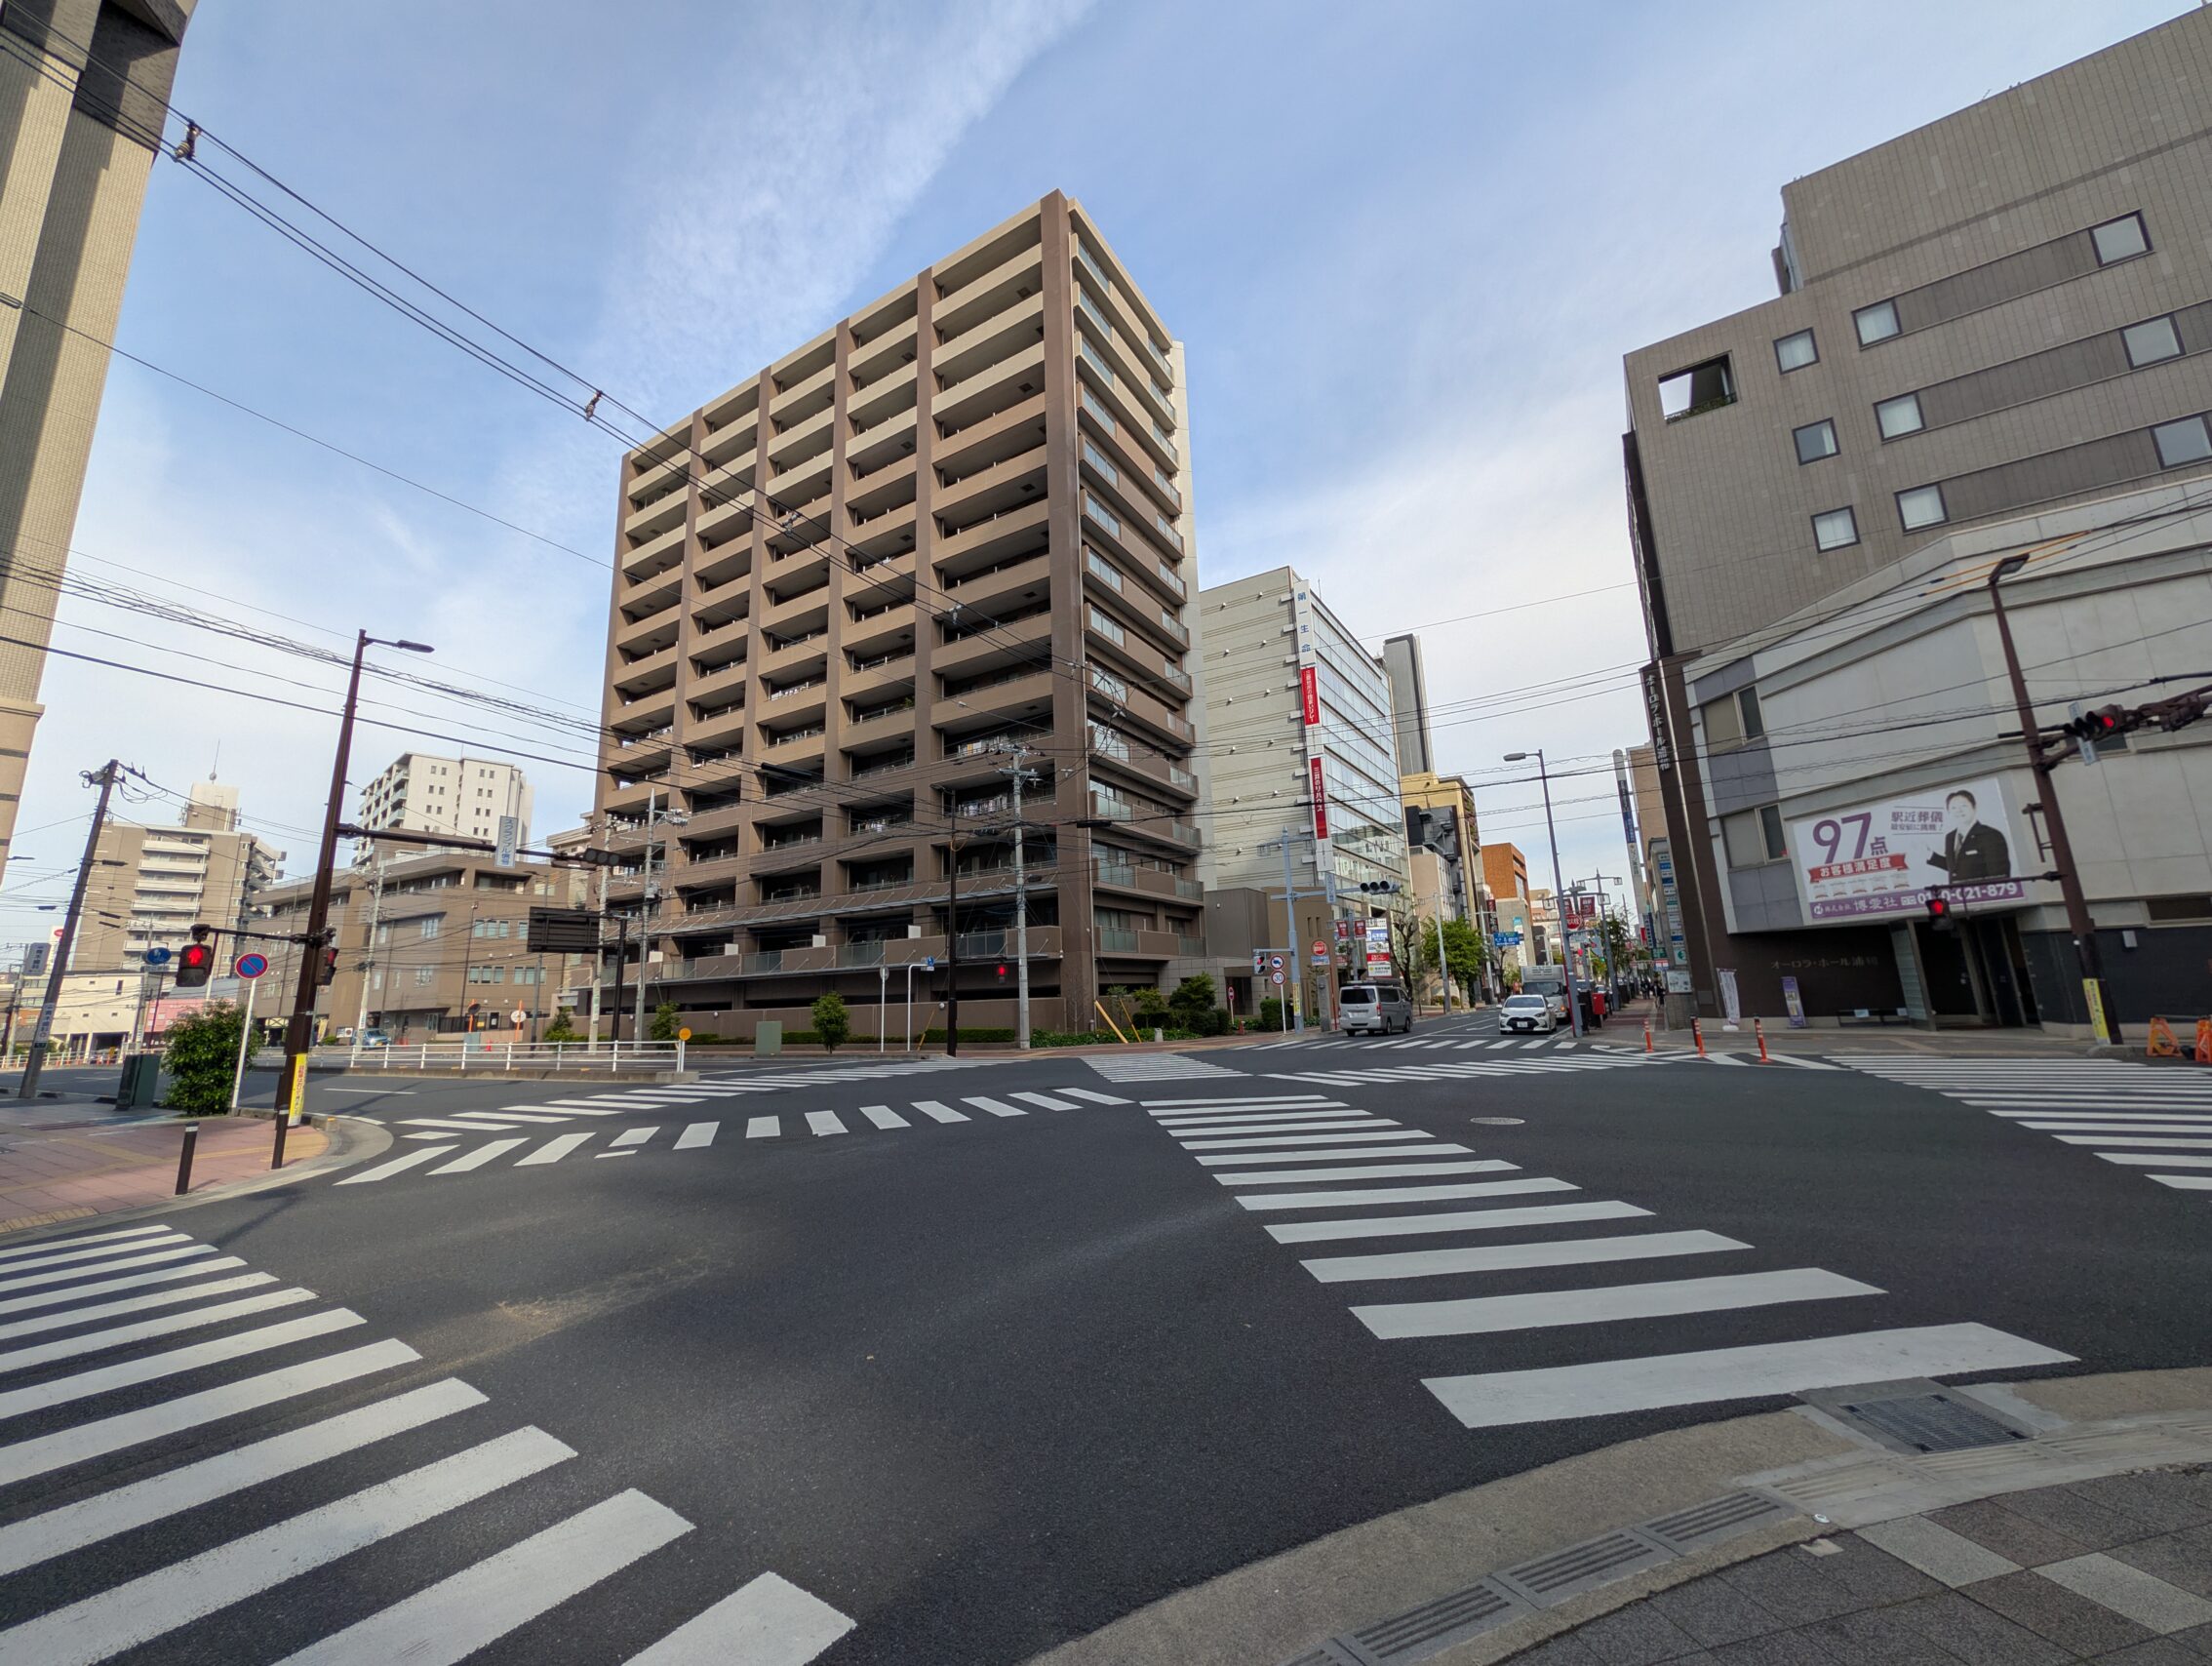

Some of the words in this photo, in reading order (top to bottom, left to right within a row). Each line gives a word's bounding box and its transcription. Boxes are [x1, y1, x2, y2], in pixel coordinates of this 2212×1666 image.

[1819, 856, 1893, 878] お客様満足度
